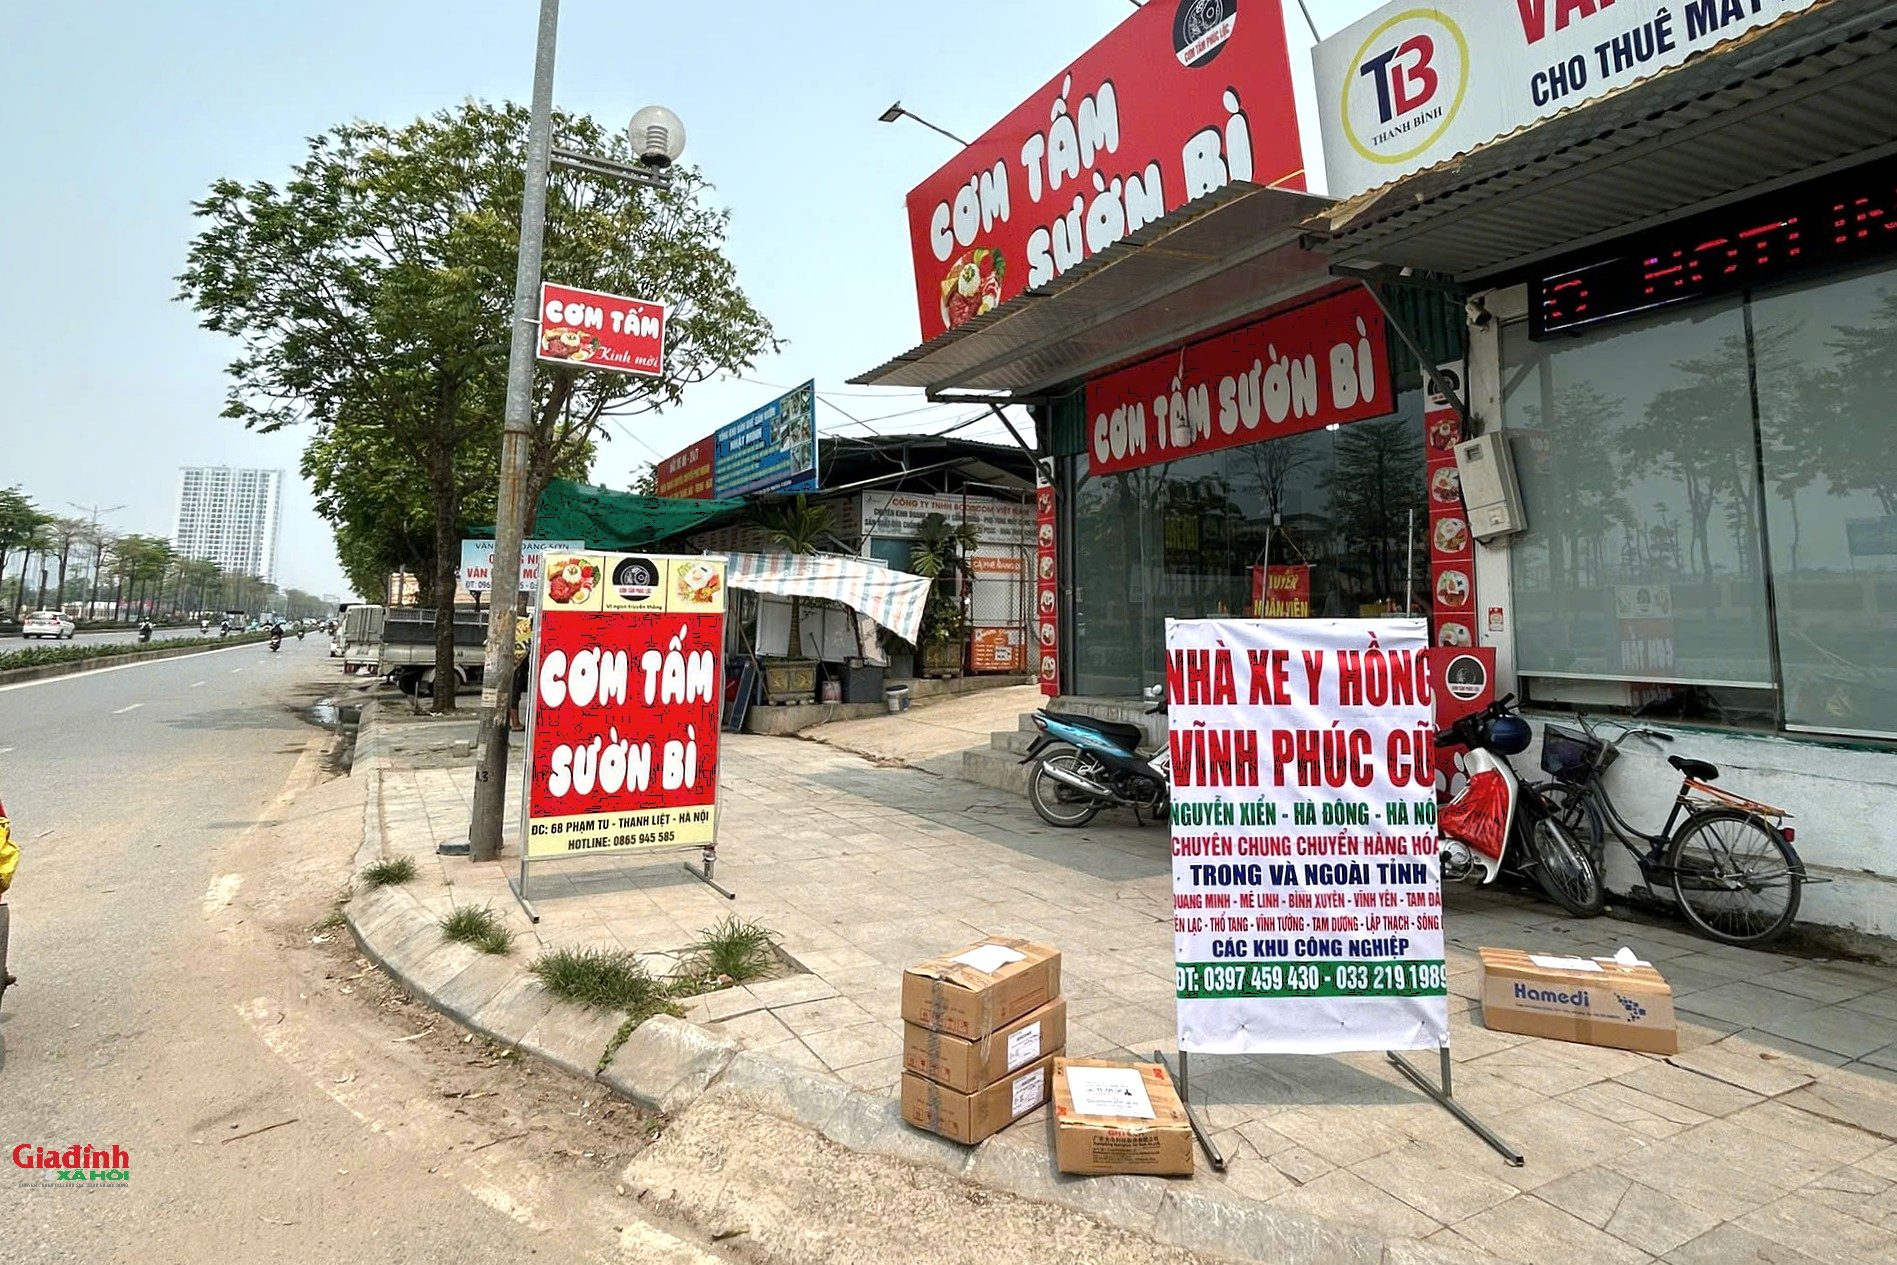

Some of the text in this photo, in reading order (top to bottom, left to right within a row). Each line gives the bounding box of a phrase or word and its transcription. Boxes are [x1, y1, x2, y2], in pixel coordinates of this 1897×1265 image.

[1530, 54, 1587, 106] CHO
[1595, 7, 1676, 79] THUÊ
[1371, 106, 1443, 146] THANH BÌNH
[930, 73, 1119, 261] CƠM TẤM
[1027, 88, 1254, 290] SƯỜN BÌ
[545, 300, 660, 340] CƠM TẤM
[1094, 401, 1146, 464] CƠM
[1219, 343, 1317, 434] SƯỜN
[1329, 316, 1375, 409] BÌ
[540, 624, 714, 707] CƠM TẤM
[1166, 640, 1237, 705] NHÀ
[1247, 649, 1292, 705] XE
[1301, 650, 1324, 705] Y
[549, 724, 697, 797] SƯỜN BÌ
[1169, 720, 1259, 787] VĨNH
[1271, 720, 1375, 787] PHÚC
[1387, 720, 1436, 787] CŨ
[531, 809, 709, 835] ĐC: 68 PHẠM TU THANH LIỆT HÀ NỘI
[1171, 794, 1234, 826] NGUYỄN
[1239, 794, 1276, 825] XIỂN
[1294, 798, 1317, 826] HÀ
[1322, 798, 1369, 826] ĐÔNG
[1386, 798, 1409, 825] HÀ
[568, 830, 675, 850] HOTLINE: 0865 945 585
[1171, 827, 1439, 856] CHUYÊN CHUNG CHUYỂN HÀNG HÓA
[1190, 858, 1427, 886] TRONG VÀ NGOÀI TỈNH
[1205, 893, 1230, 908] MINH
[1240, 890, 1254, 908] MÊ
[1257, 893, 1279, 908] LINH
[1288, 890, 1312, 908] BÌNH
[1315, 890, 1345, 908] XUYÊN
[1353, 890, 1376, 908] VĨNH
[1378, 889, 1397, 907] YÊN
[1406, 892, 1426, 907] TAM
[1187, 917, 1202, 936] LẠC
[1210, 911, 1225, 932] THỔ
[1227, 916, 1248, 932] TANG
[1256, 913, 1275, 932] VĨNH
[1277, 913, 1304, 932] TƯỜNG
[1312, 916, 1329, 932] TAM
[1332, 915, 1358, 932] DƯƠNG
[1366, 912, 1380, 934] LẬP
[1382, 915, 1409, 934] THẠCH
[1417, 912, 1439, 931] SÔNG
[1212, 935, 1409, 959] CÁC KHU CÔNG NGHIỆP
[1203, 966, 1246, 991] 0397
[1251, 966, 1282, 990] 459
[1288, 965, 1319, 990] 430
[1336, 965, 1368, 989] 033
[1373, 965, 1405, 989] 219
[1514, 983, 1590, 1007] Hamedi
